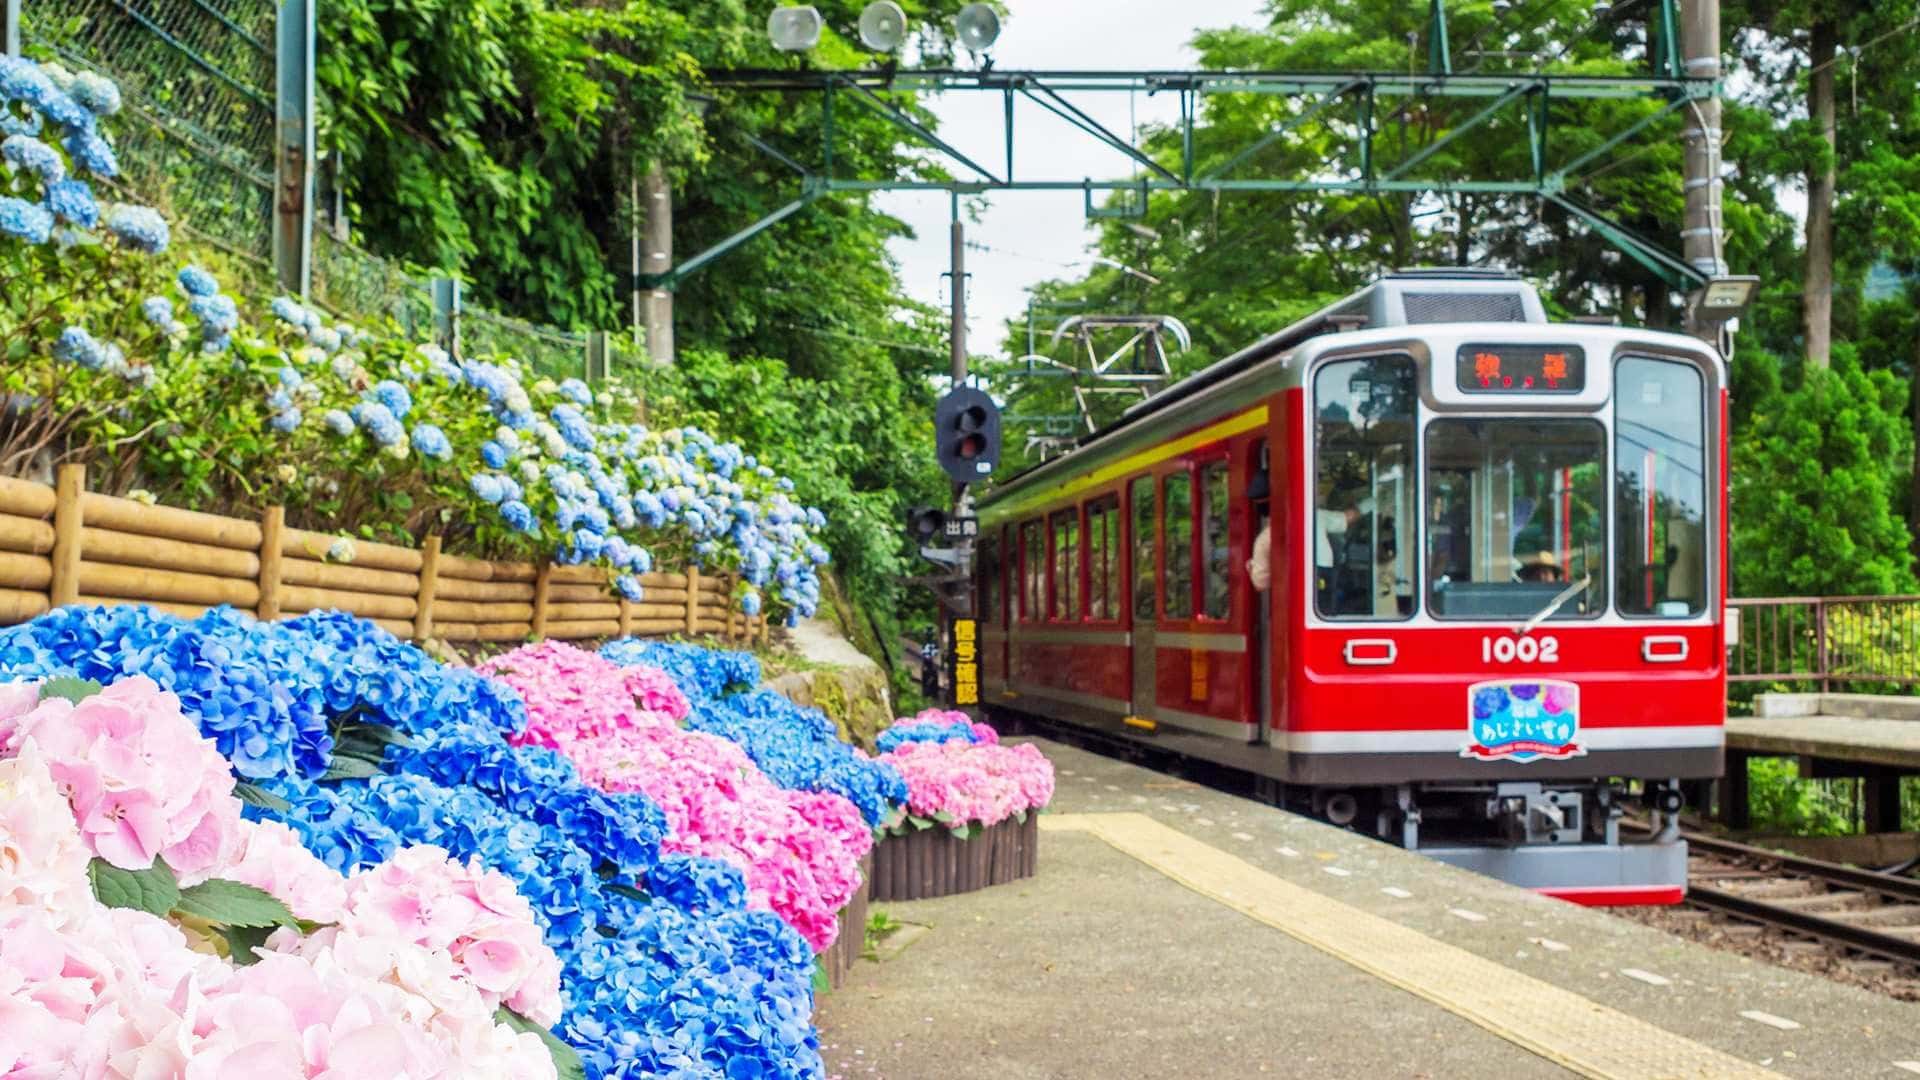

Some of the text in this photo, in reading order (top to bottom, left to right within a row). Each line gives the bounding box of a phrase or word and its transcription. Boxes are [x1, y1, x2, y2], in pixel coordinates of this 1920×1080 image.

[946, 520, 977, 535] 出発
[955, 619, 978, 704] 信号確認
[1482, 636, 1559, 663] 1002
